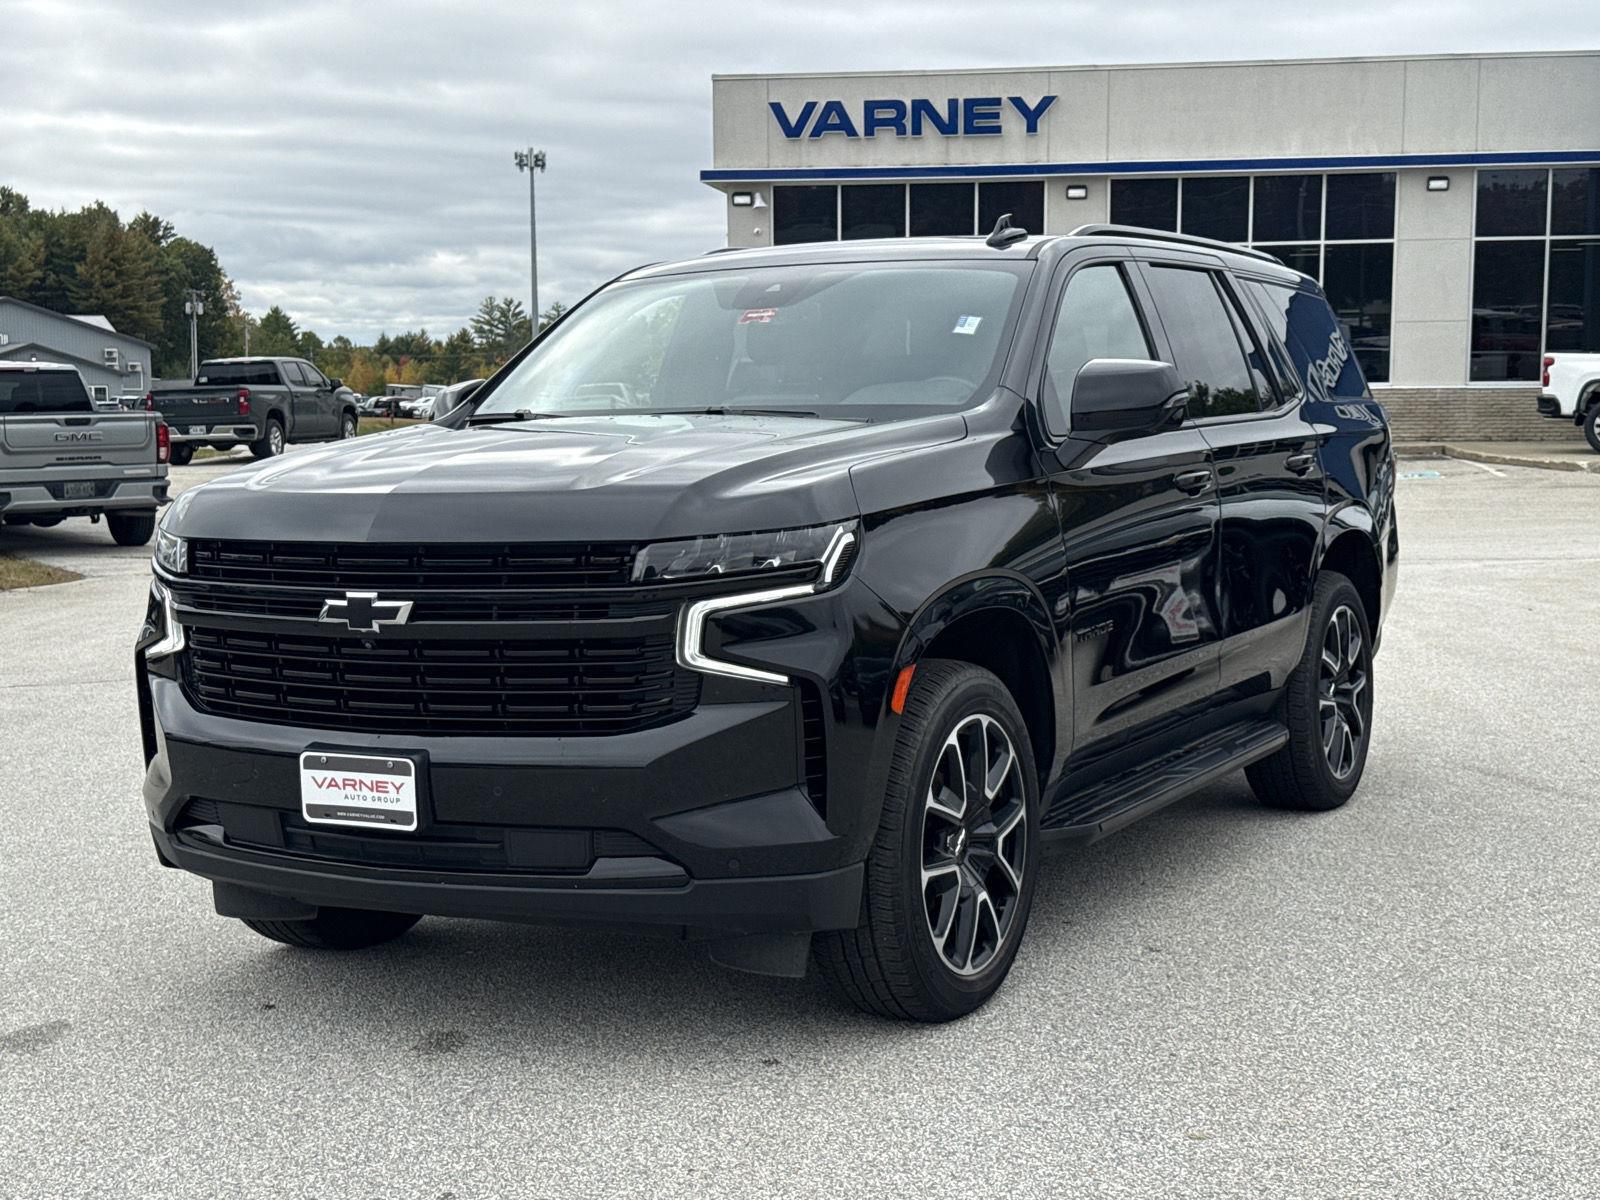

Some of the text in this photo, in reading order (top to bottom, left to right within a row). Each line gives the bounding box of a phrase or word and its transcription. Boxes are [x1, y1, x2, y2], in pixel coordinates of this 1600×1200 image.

[768, 95, 1058, 139] VARNEY
[54, 431, 104, 441] GMC
[311, 776, 405, 795] VARNEY
[344, 793, 401, 804] AUTO GROUP
